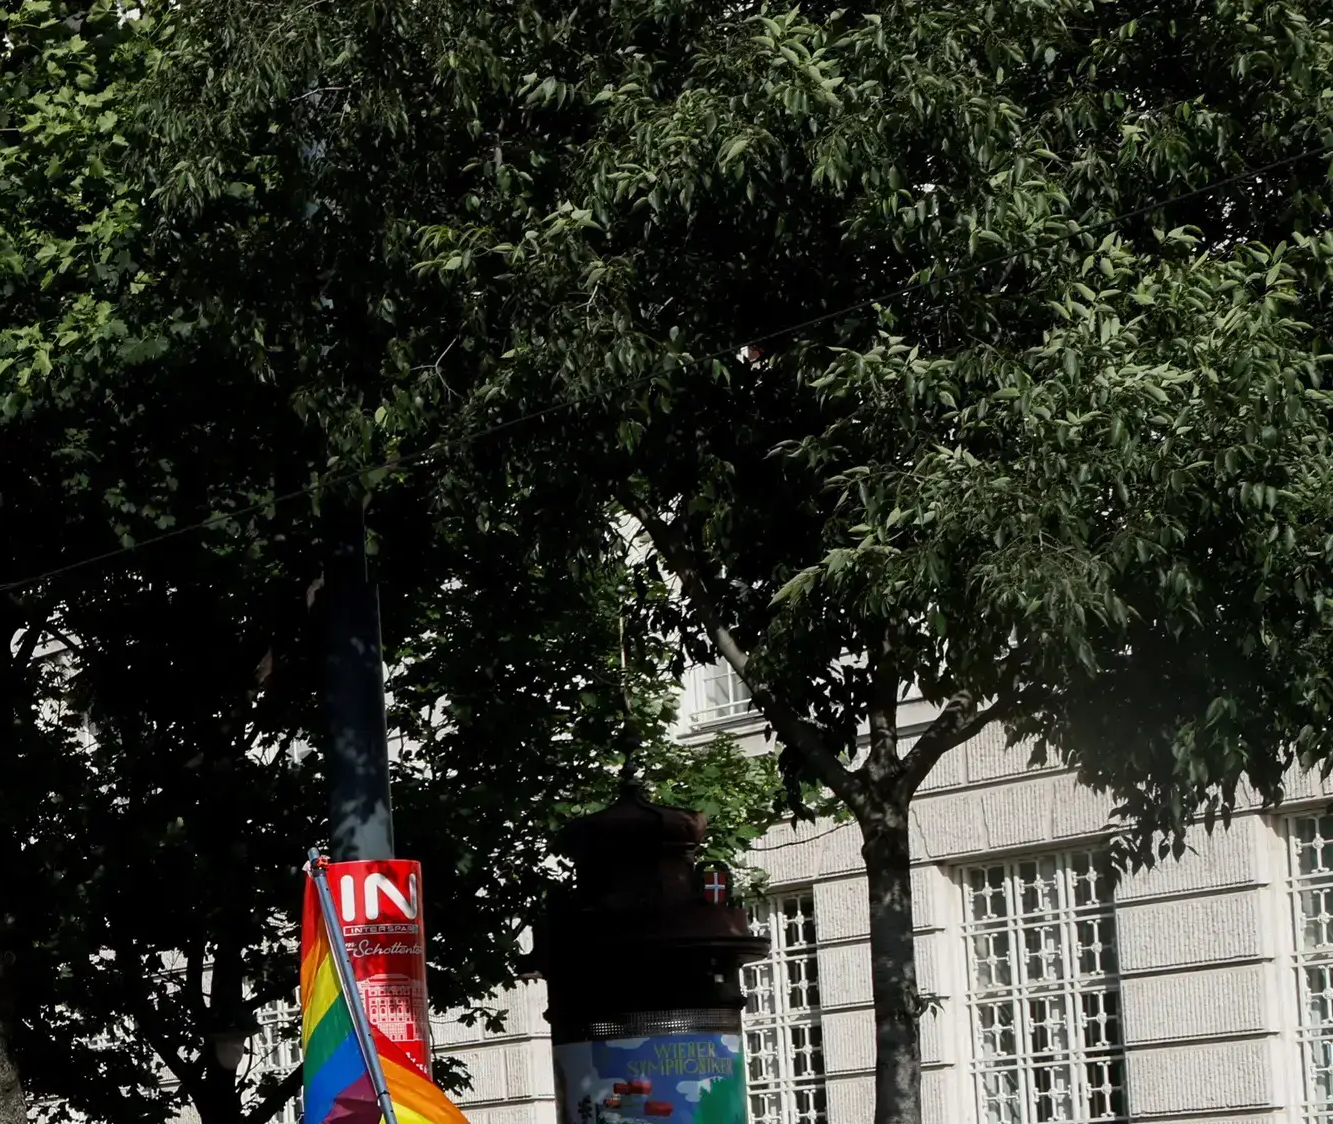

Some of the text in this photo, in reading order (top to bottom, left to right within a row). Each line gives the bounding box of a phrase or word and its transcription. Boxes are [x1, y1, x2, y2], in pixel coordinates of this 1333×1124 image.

[340, 873, 417, 921] IN
[353, 939, 423, 957] Schottent
[653, 1041, 716, 1059] WIENER
[627, 1058, 732, 1076] SYMPHONIKER
